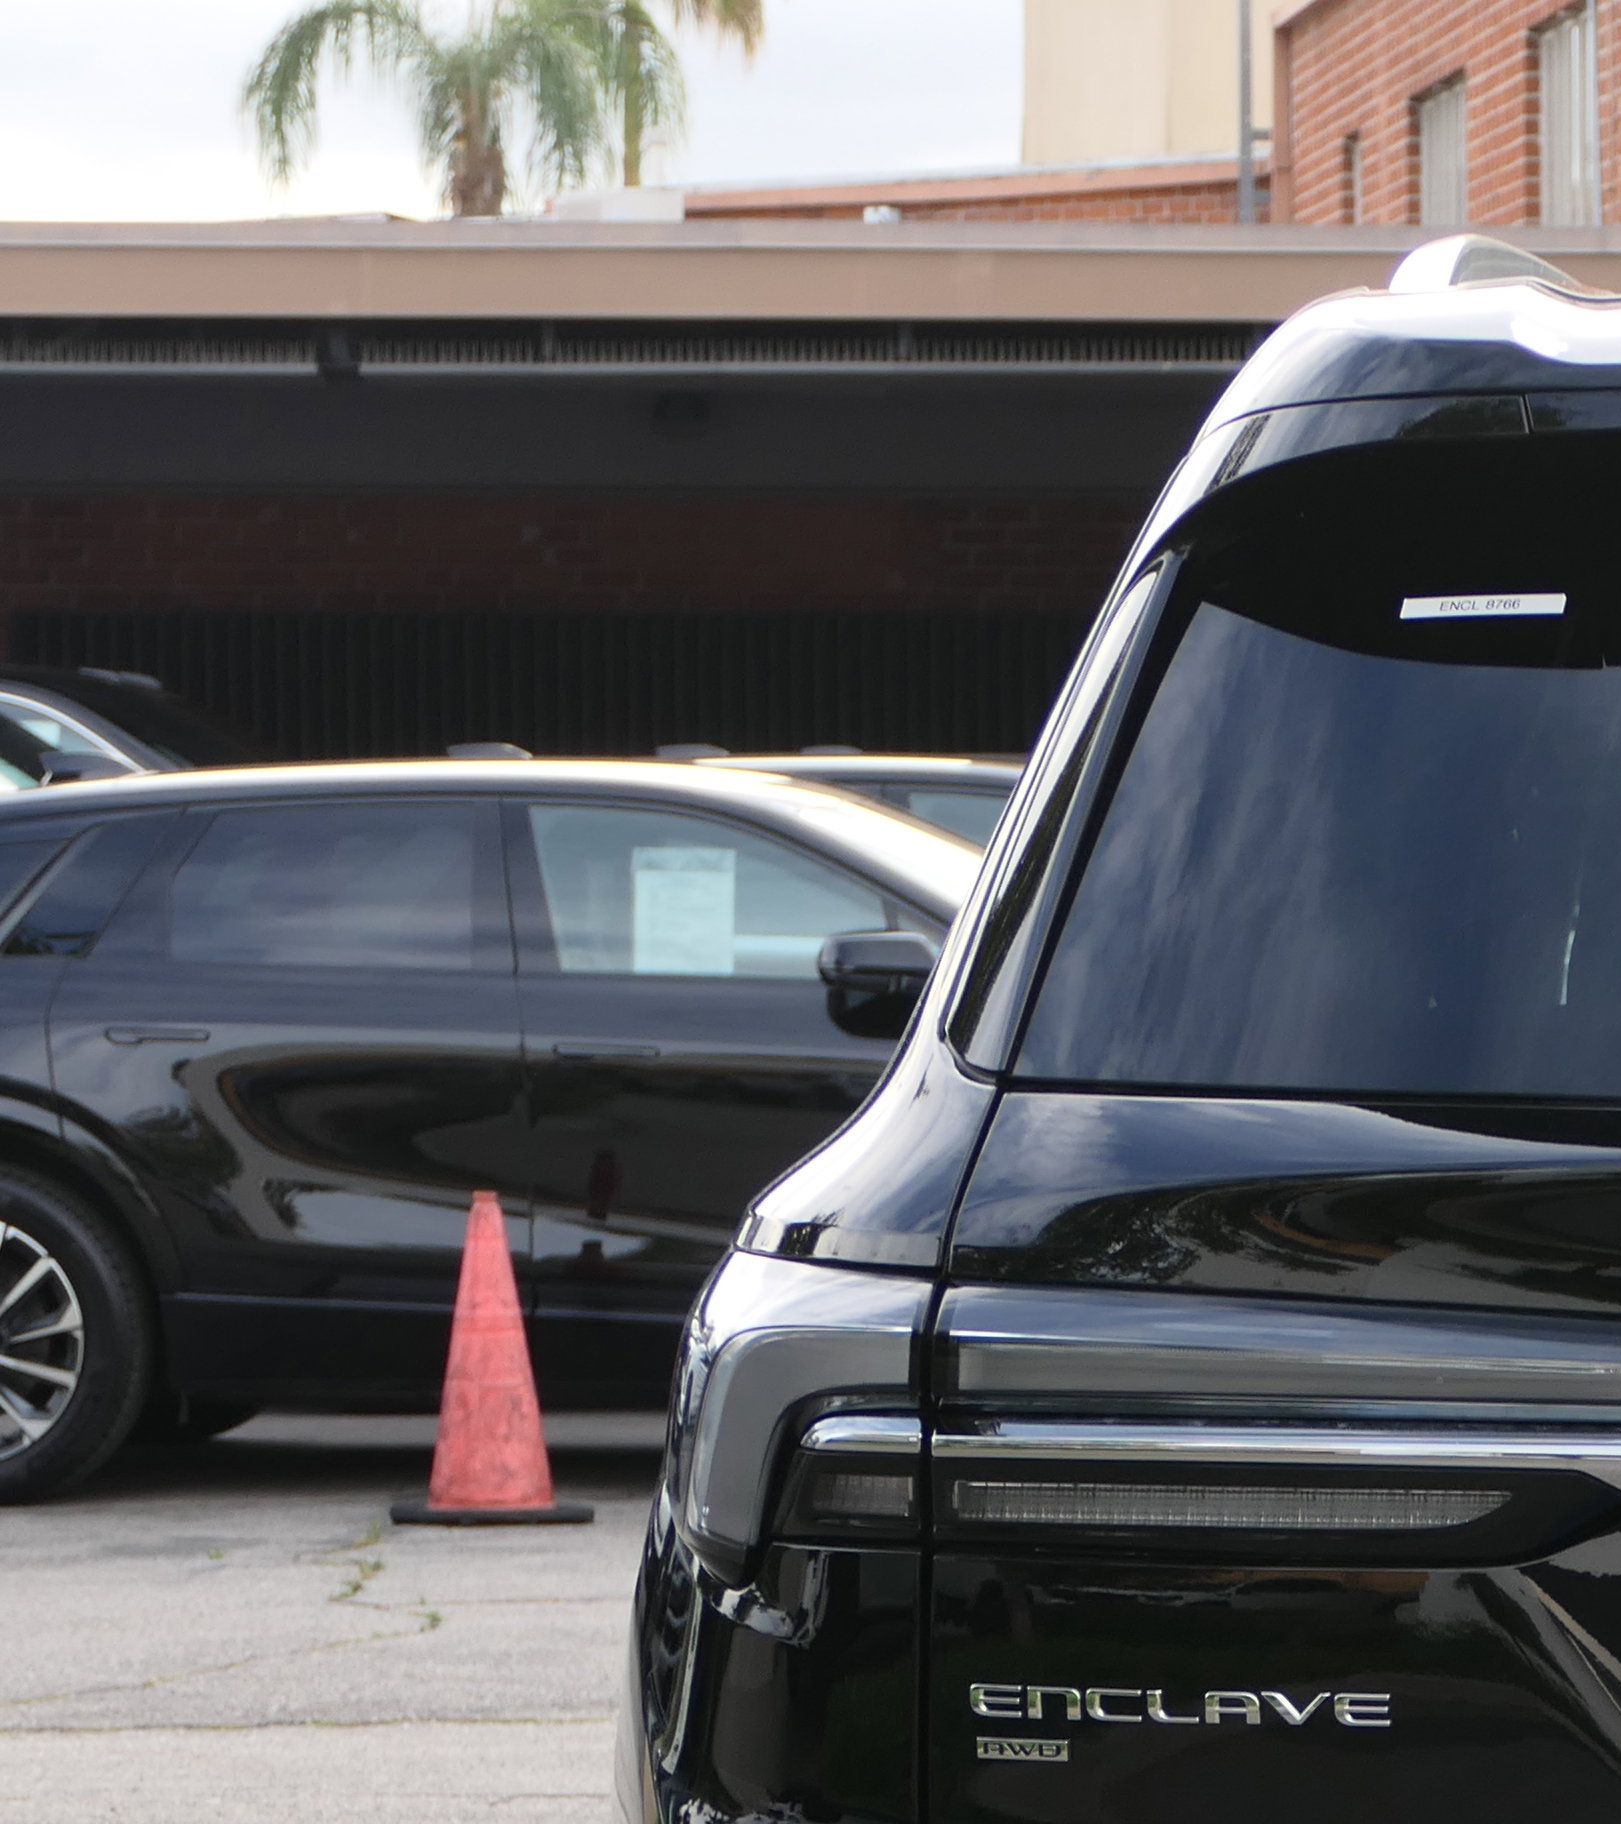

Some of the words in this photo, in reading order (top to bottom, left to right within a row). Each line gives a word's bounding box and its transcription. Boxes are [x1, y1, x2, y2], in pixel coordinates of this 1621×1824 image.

[1438, 599, 1480, 612] ENCL
[969, 1682, 1392, 1728] ENCLAVE
[982, 1741, 1063, 1759] AWD
